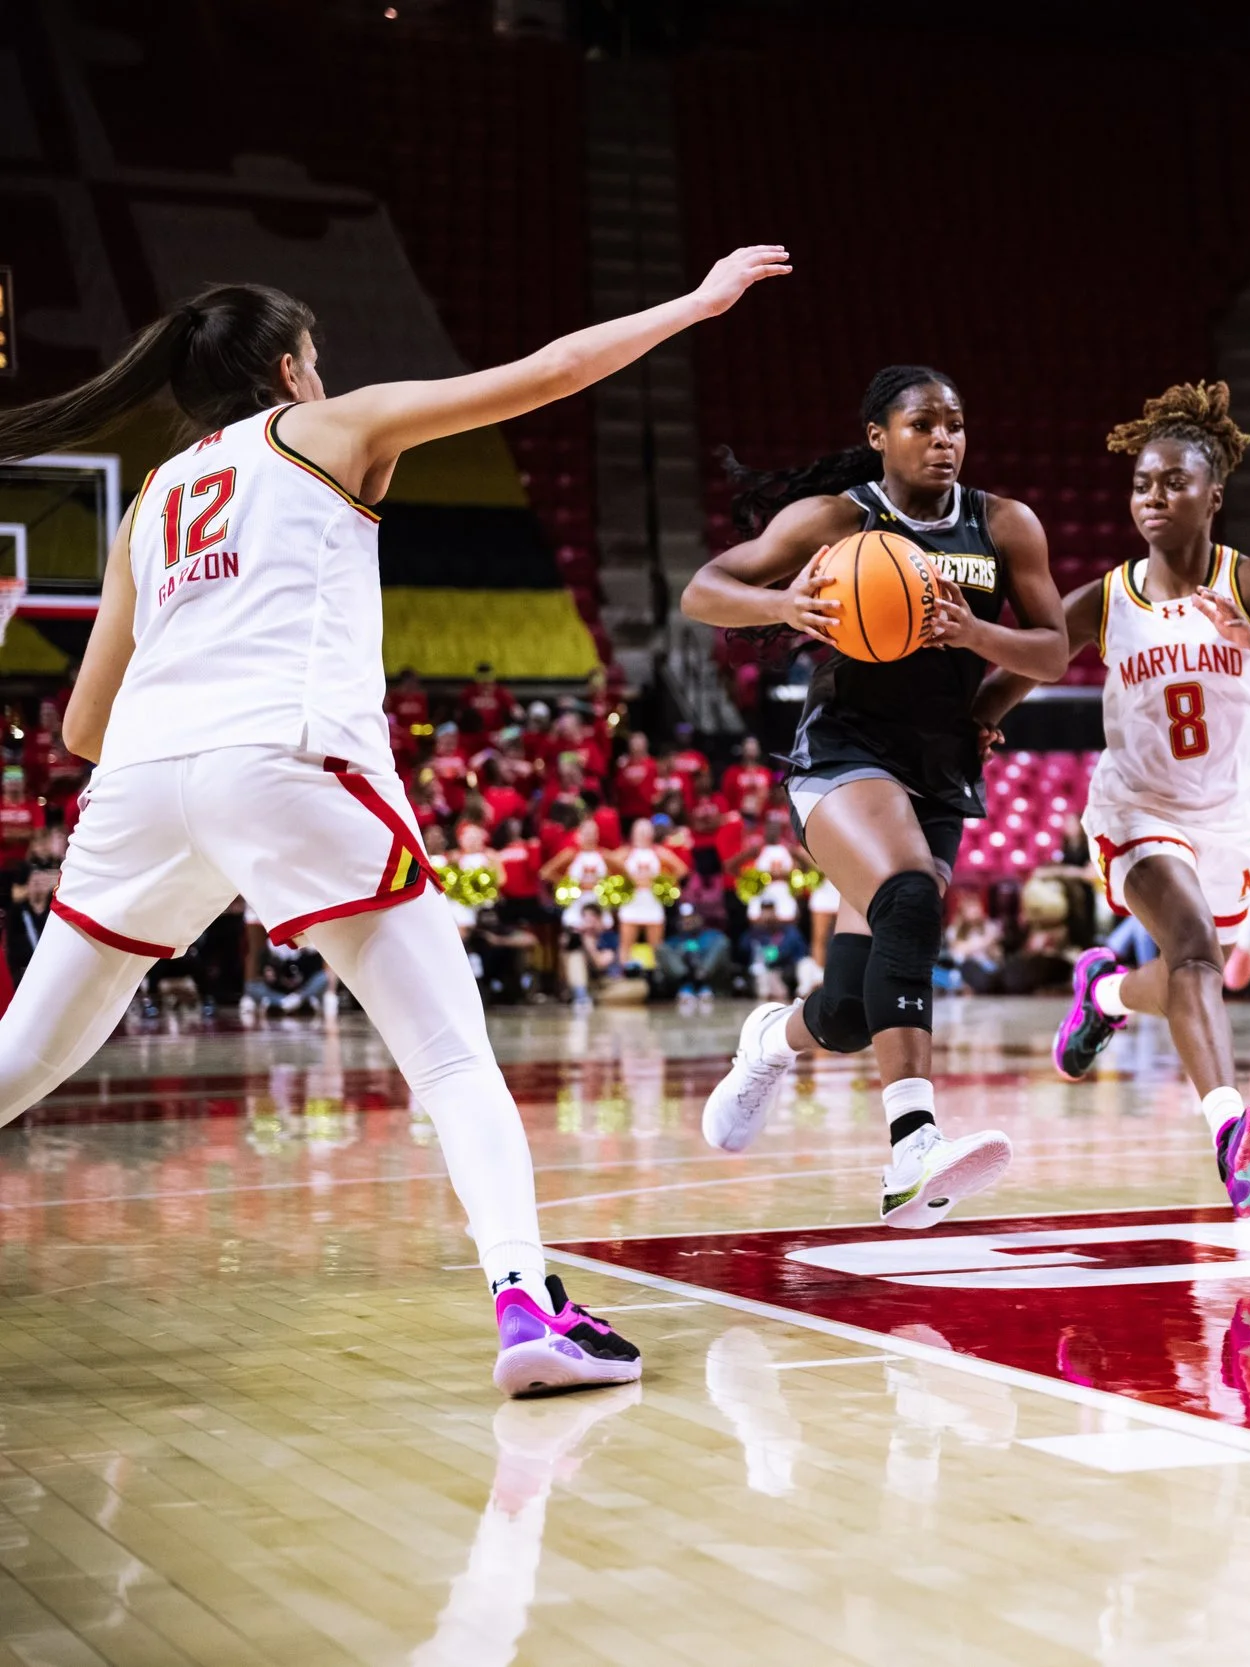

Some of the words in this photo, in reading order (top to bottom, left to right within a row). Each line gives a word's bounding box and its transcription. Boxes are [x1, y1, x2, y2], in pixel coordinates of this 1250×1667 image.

[161, 466, 236, 569] 12
[158, 552, 239, 607] GARZON
[1119, 643, 1243, 690] MARYLAND
[1163, 681, 1210, 760] 8
